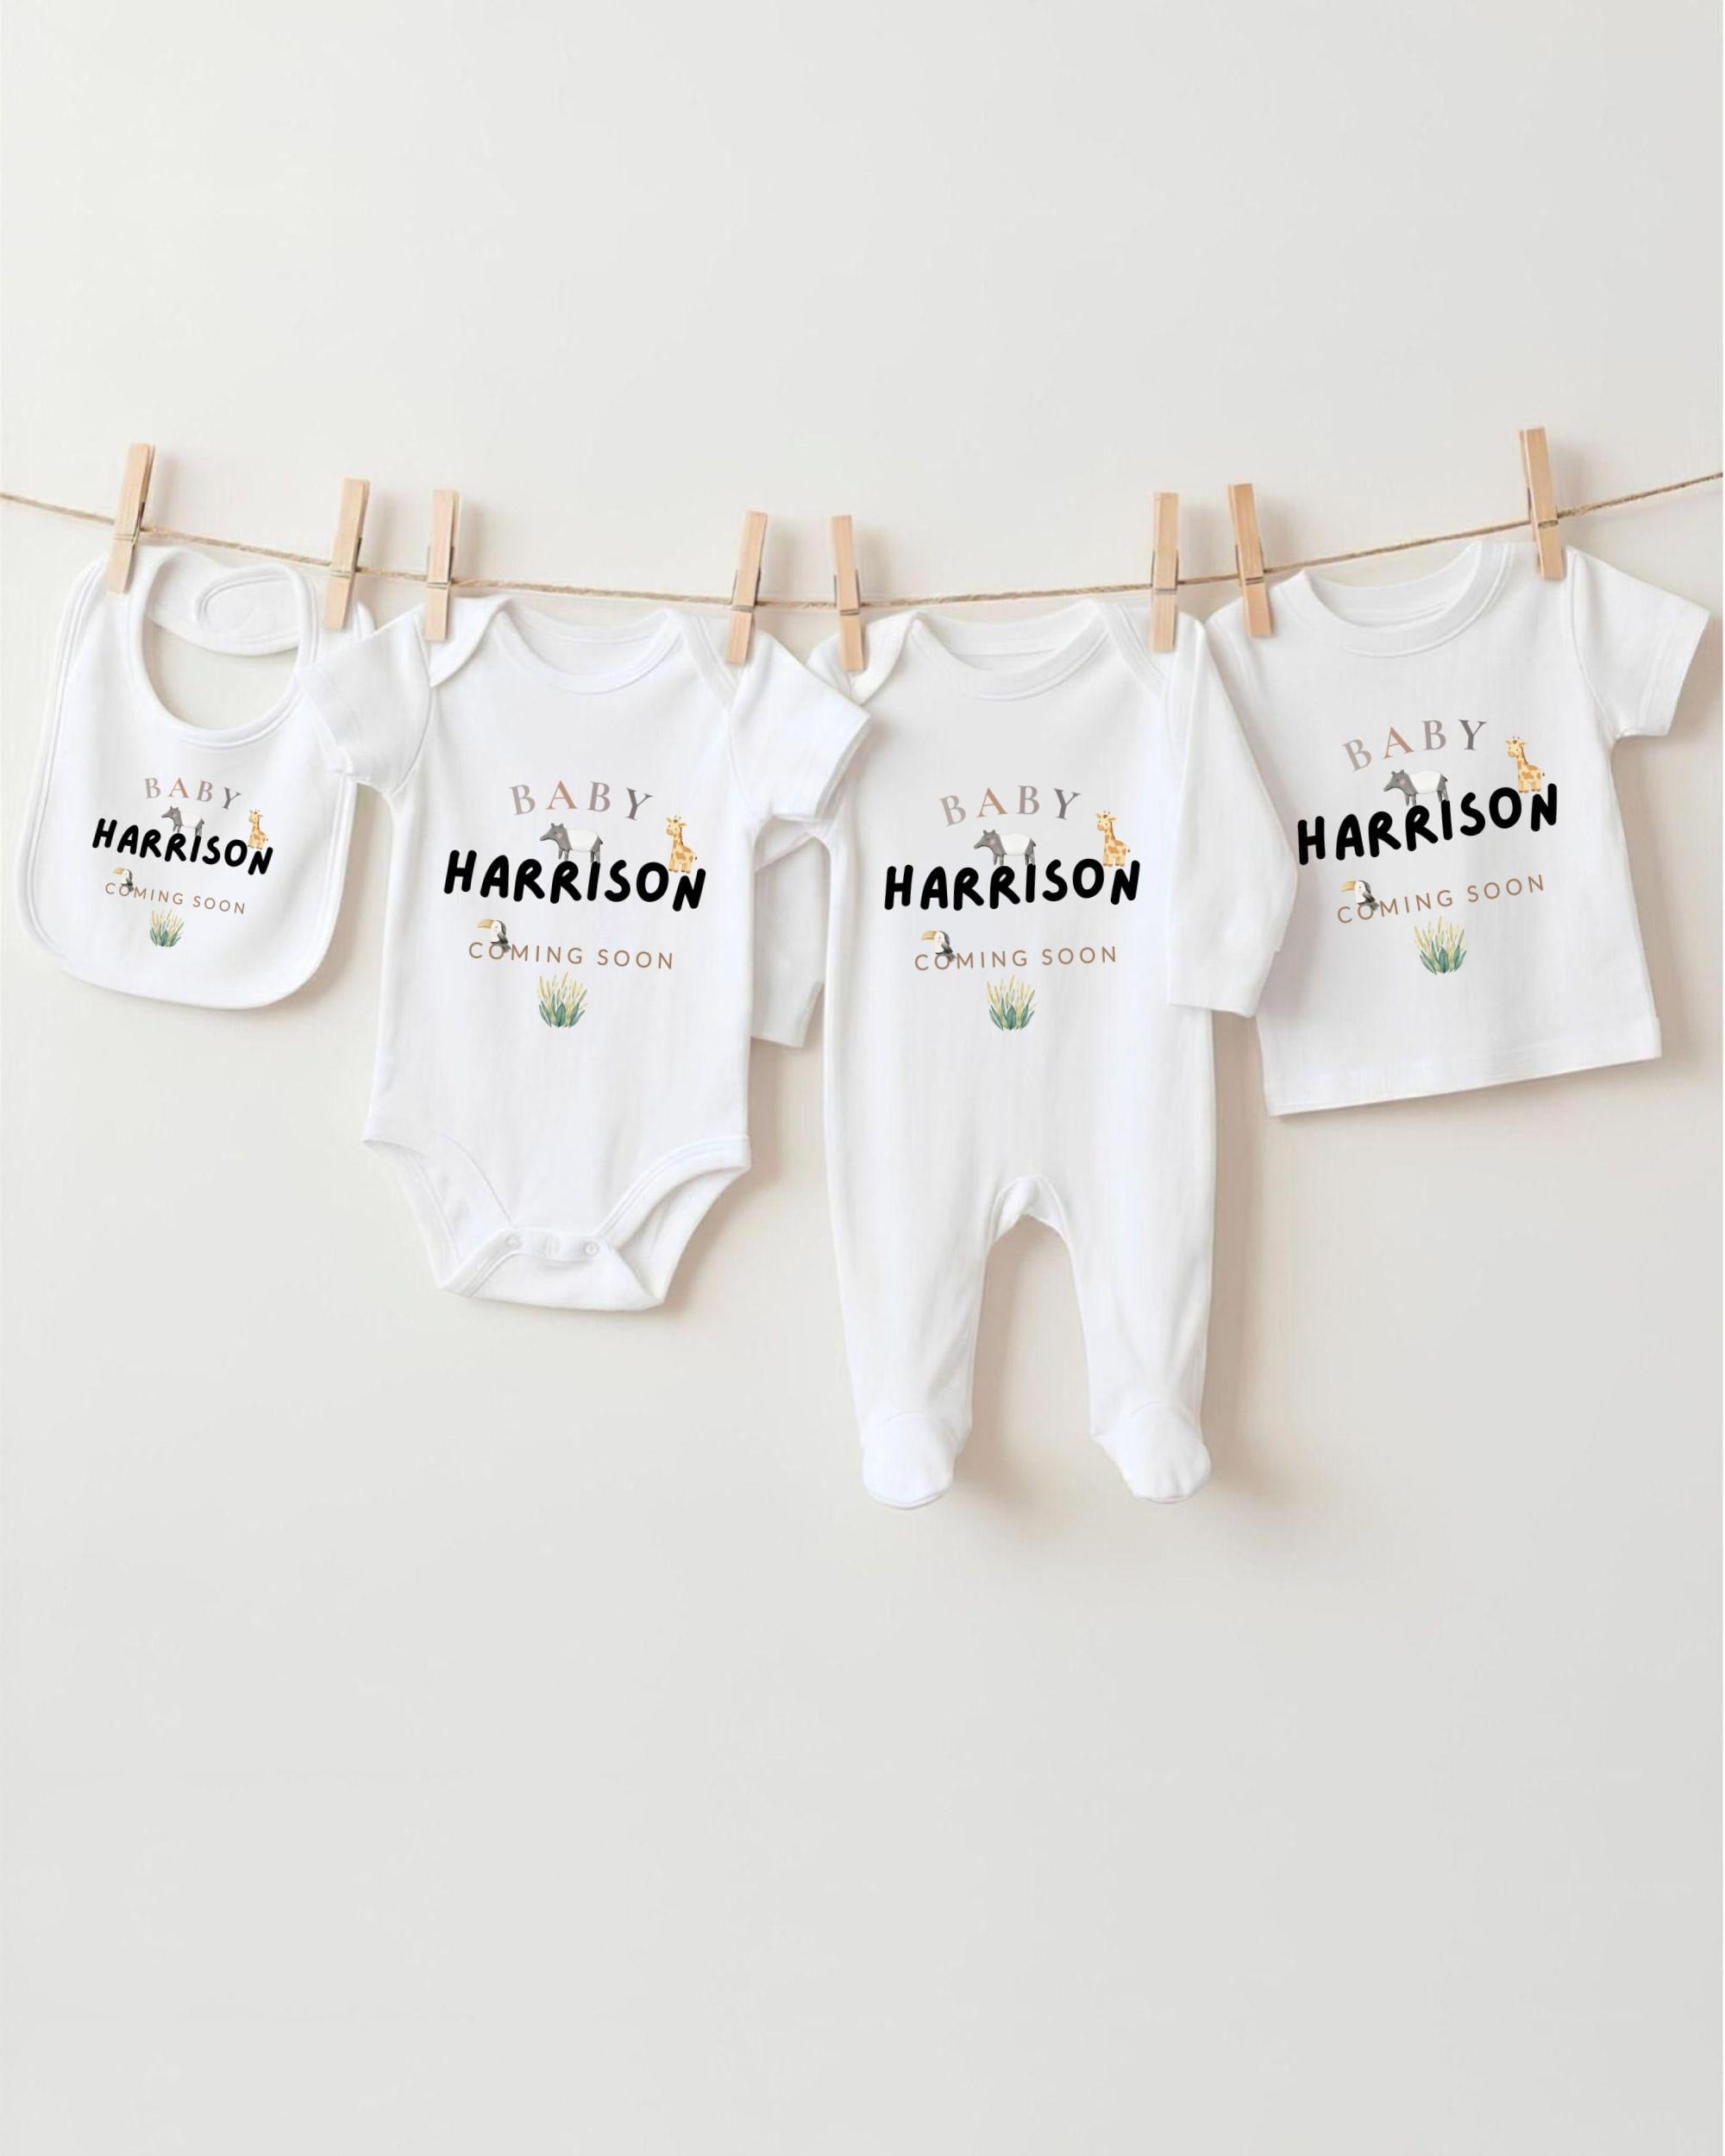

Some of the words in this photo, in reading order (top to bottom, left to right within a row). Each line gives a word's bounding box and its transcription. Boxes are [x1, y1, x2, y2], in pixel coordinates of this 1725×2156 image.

[1342, 718, 1488, 772] BABY
[144, 777, 242, 811] BABY
[510, 780, 654, 821] BABY
[939, 785, 1082, 826] BABY
[92, 818, 273, 875] HARRISON
[1297, 783, 1558, 866] HARRISON
[104, 882, 185, 906] COMING
[192, 895, 246, 915] SOON
[444, 849, 706, 912] HARRISON
[884, 858, 1140, 912] HARRISON
[1337, 889, 1453, 924] COMING
[1466, 874, 1544, 904] SOON
[468, 941, 584, 965] COMING
[597, 949, 673, 970] SOON
[914, 949, 1028, 971] COMING
[1041, 945, 1116, 967] SOON
